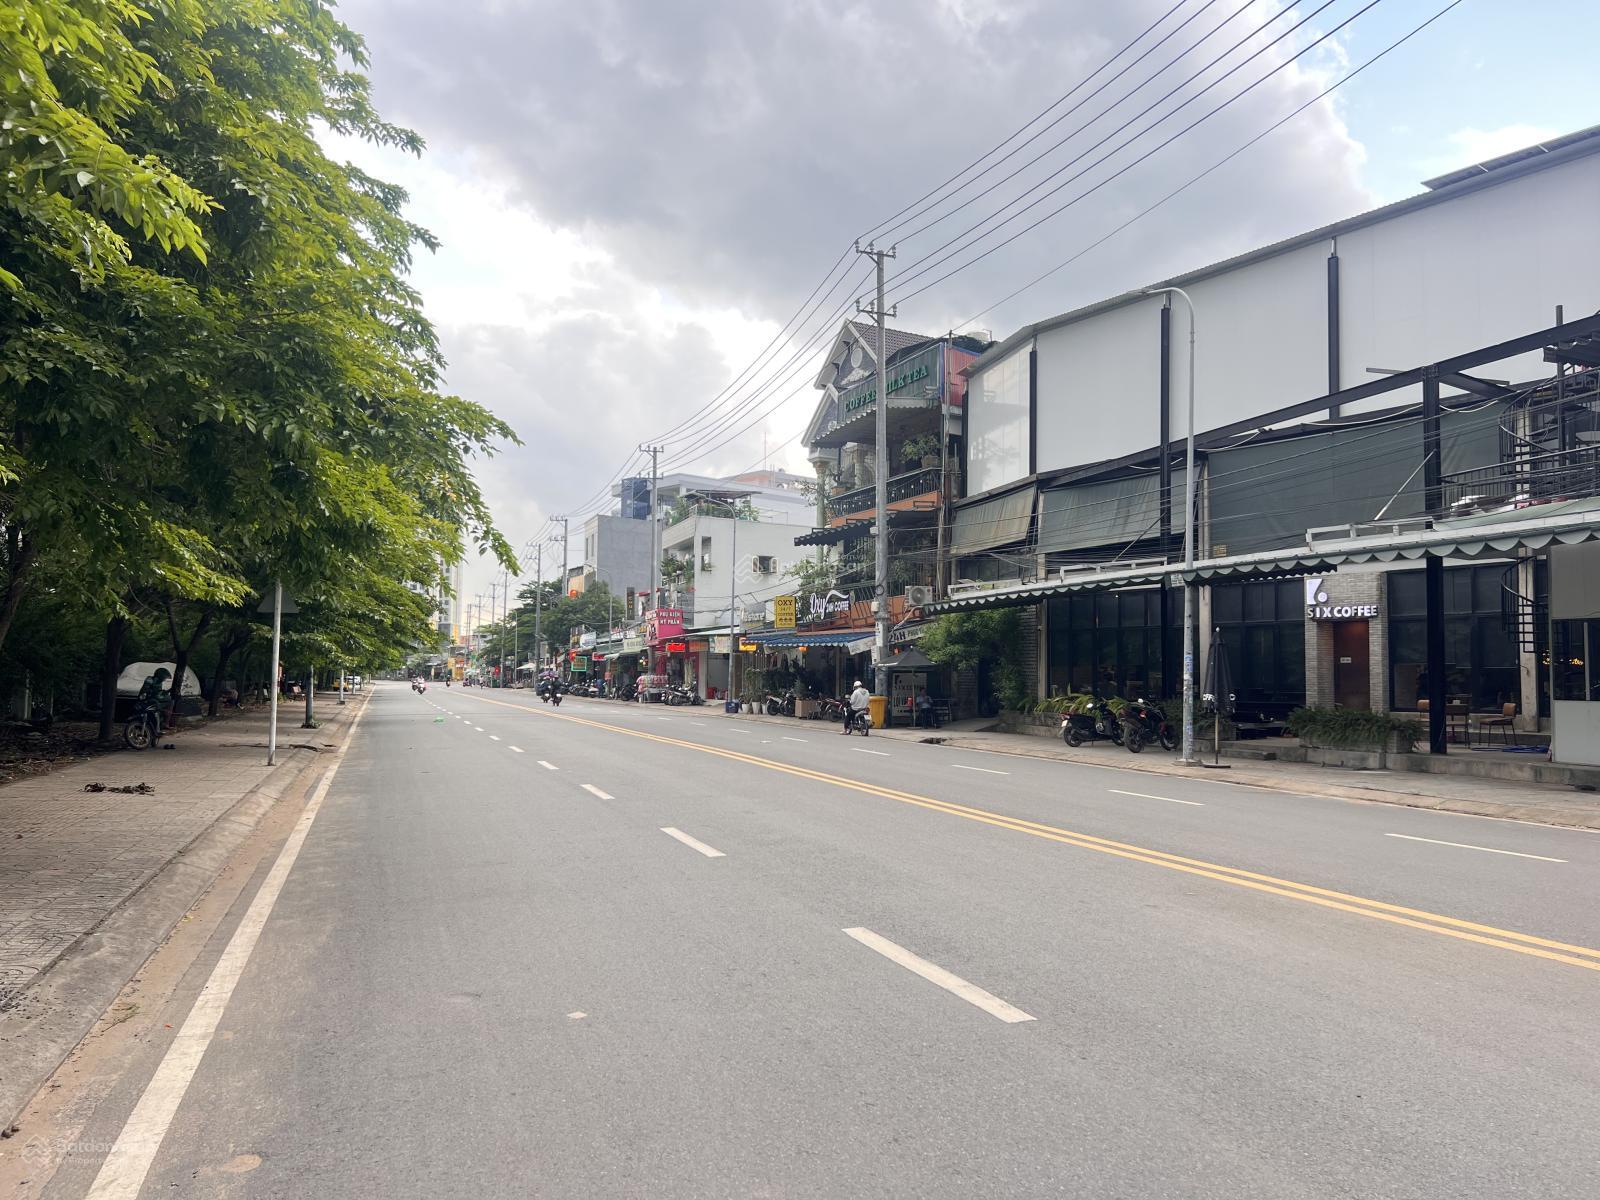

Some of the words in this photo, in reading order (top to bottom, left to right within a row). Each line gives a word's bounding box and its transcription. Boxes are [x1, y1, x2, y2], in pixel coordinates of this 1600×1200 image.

[886, 374, 905, 394] ILK
[907, 364, 929, 384] TEA
[777, 599, 793, 607] OXY
[1307, 607, 1332, 618] SIX
[1333, 605, 1378, 618] COFFEE
[888, 631, 906, 643] 24H
